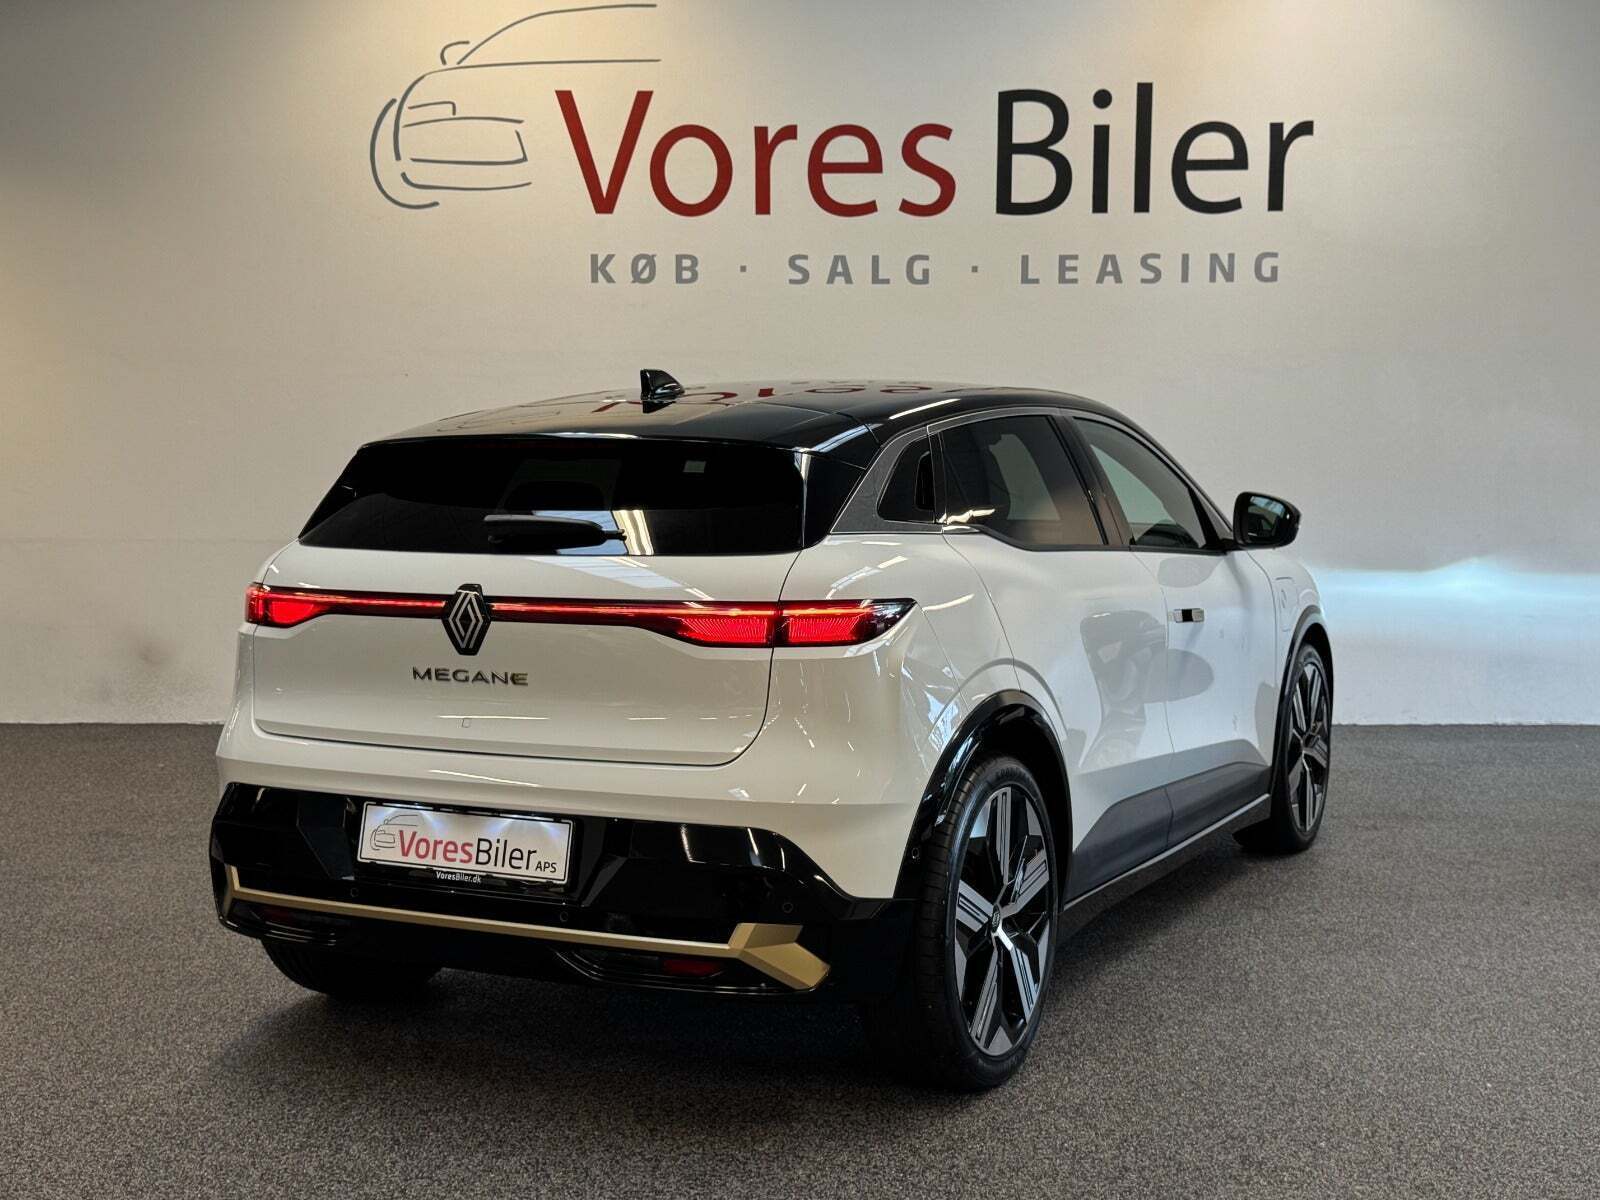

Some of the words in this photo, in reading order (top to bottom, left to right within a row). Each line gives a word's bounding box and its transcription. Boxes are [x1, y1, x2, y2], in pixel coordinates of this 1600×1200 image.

[555, 90, 957, 218] Vores
[995, 82, 1315, 216] Biler
[590, 252, 700, 285] KØB
[787, 253, 932, 285] SALG
[1020, 251, 1281, 285] LEASING
[412, 666, 529, 686] MEGANE
[535, 860, 558, 874] APS
